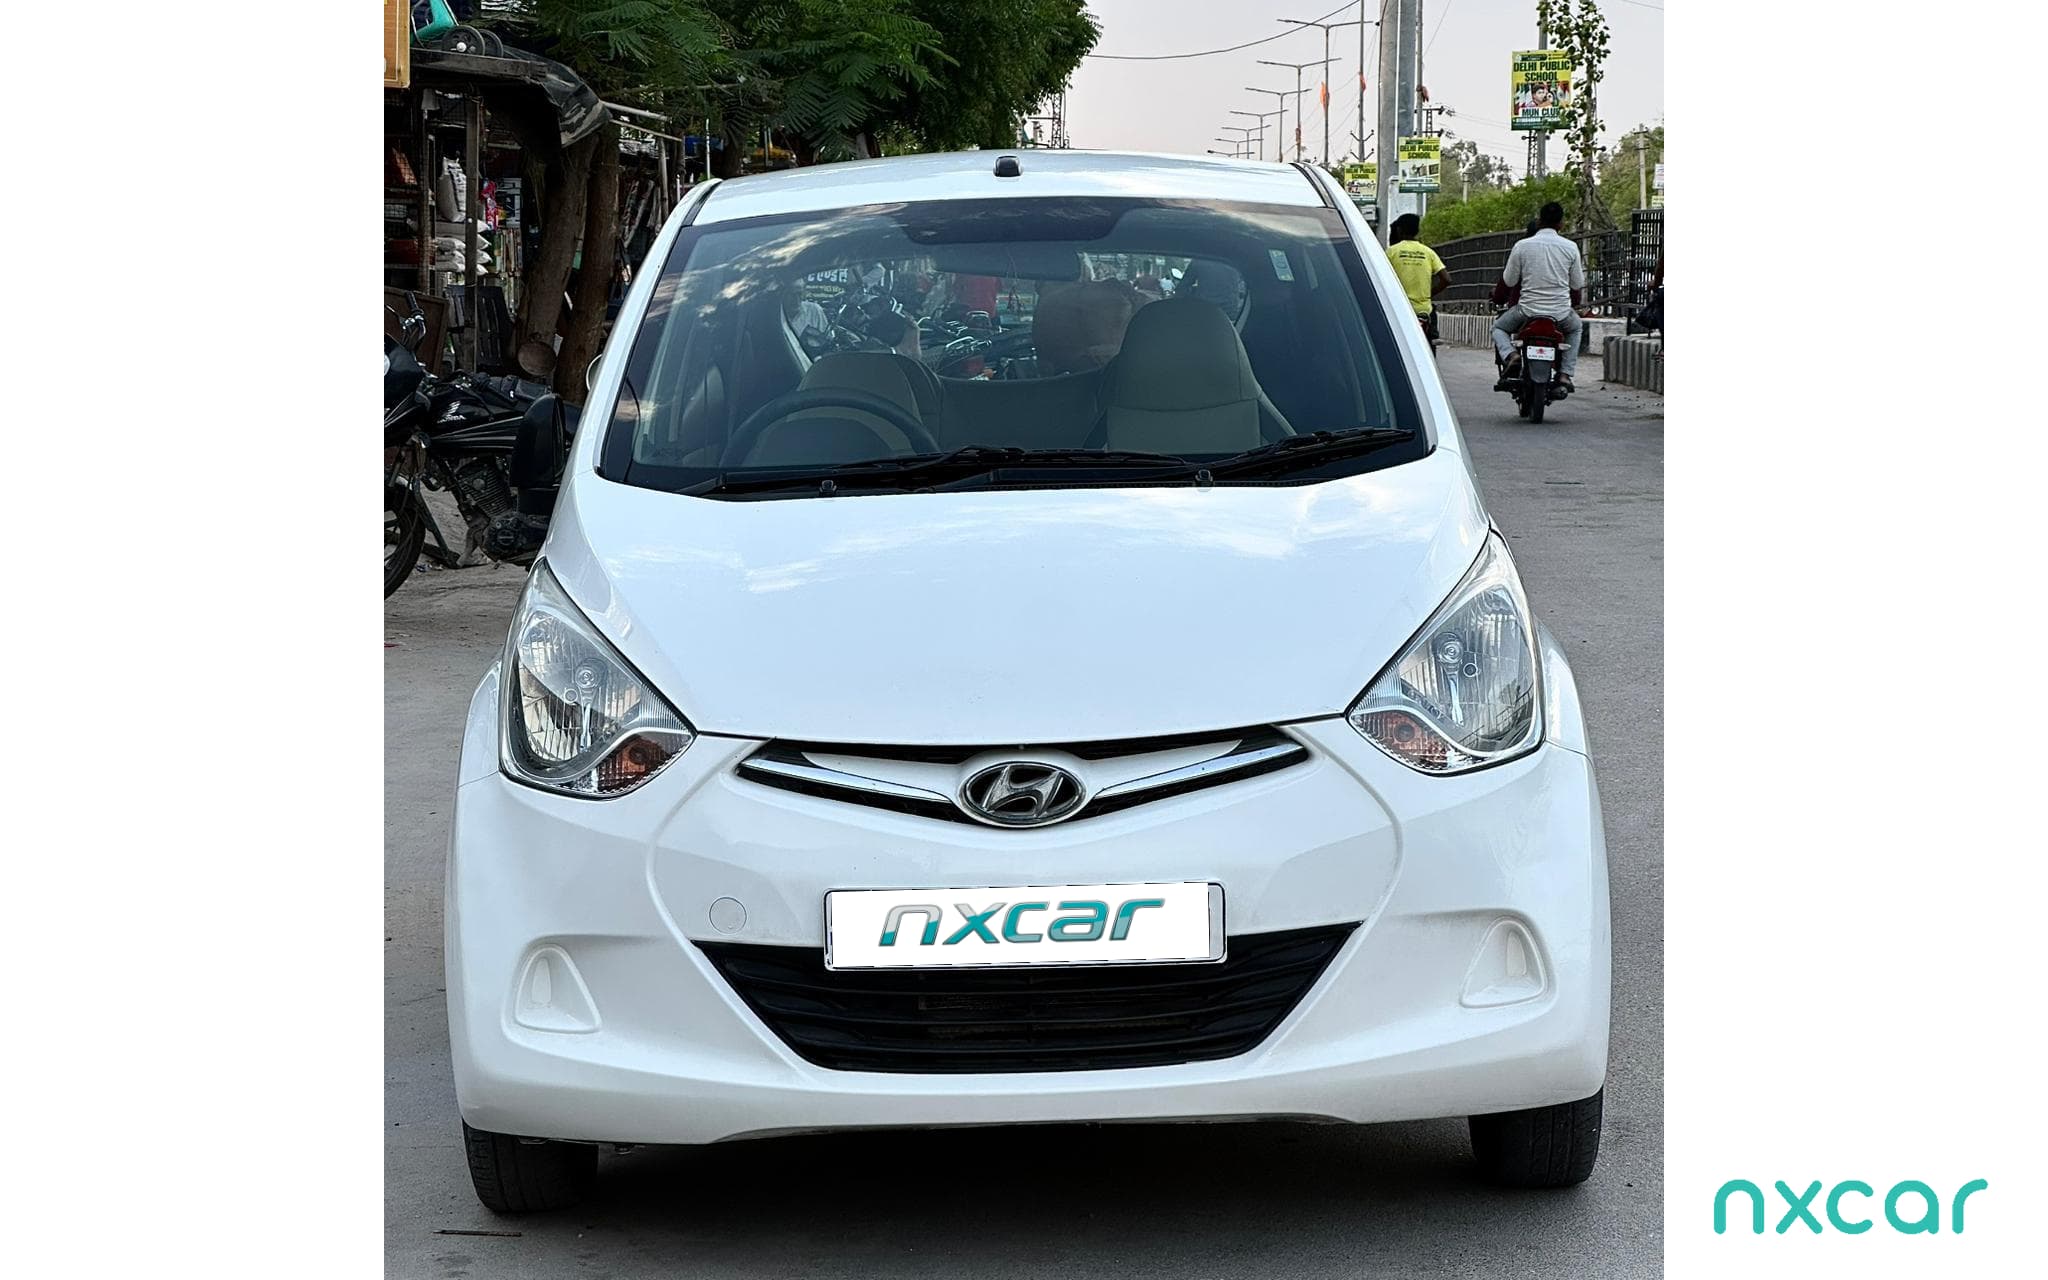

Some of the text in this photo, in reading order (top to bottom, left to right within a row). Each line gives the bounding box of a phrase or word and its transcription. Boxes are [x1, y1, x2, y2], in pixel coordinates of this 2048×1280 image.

[1513, 60, 1570, 72] DELHI PUBLIC
[1524, 71, 1558, 82] SCHOOL
